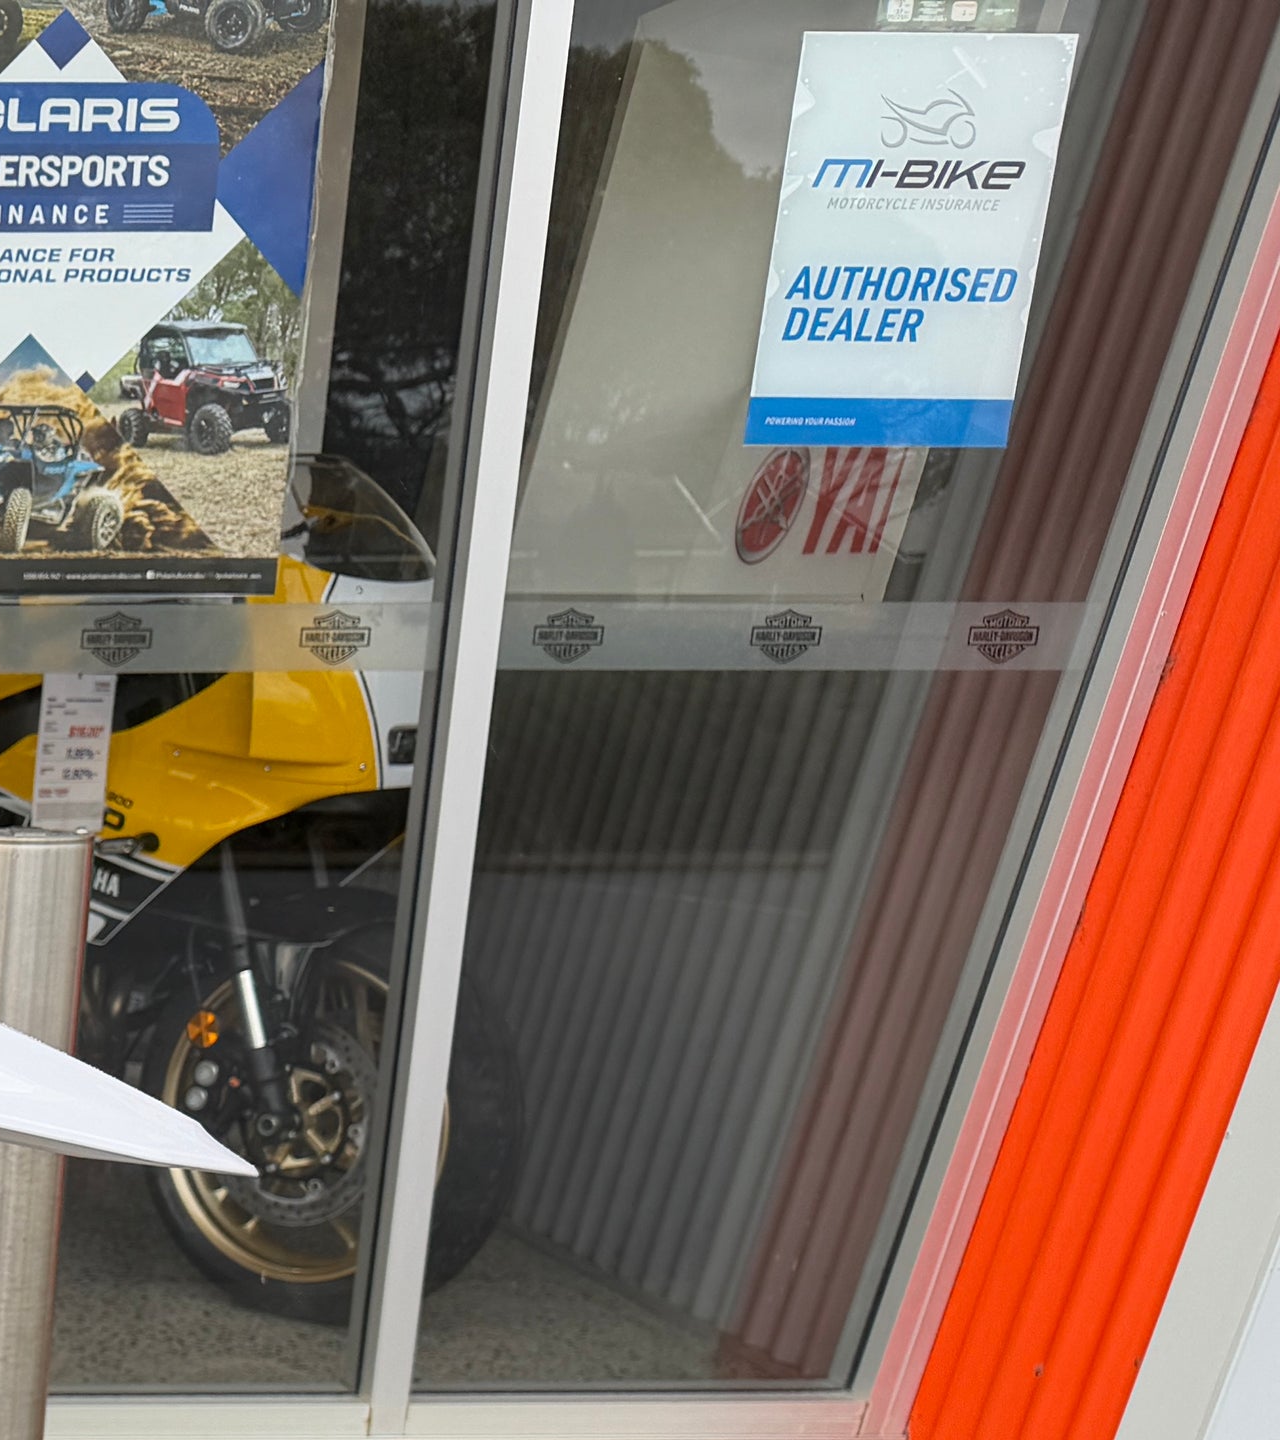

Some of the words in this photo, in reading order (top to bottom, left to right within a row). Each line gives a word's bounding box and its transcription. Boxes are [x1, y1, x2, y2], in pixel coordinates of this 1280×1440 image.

[827, 197, 917, 210] MOTORCYCLE
[920, 198, 1001, 211] INSURANCE
[68, 248, 116, 263] FOR
[63, 268, 192, 283] PRODUCTS
[784, 266, 1019, 304] AUTHORISED
[780, 307, 925, 344] DEALER
[824, 417, 857, 426] PASSION
